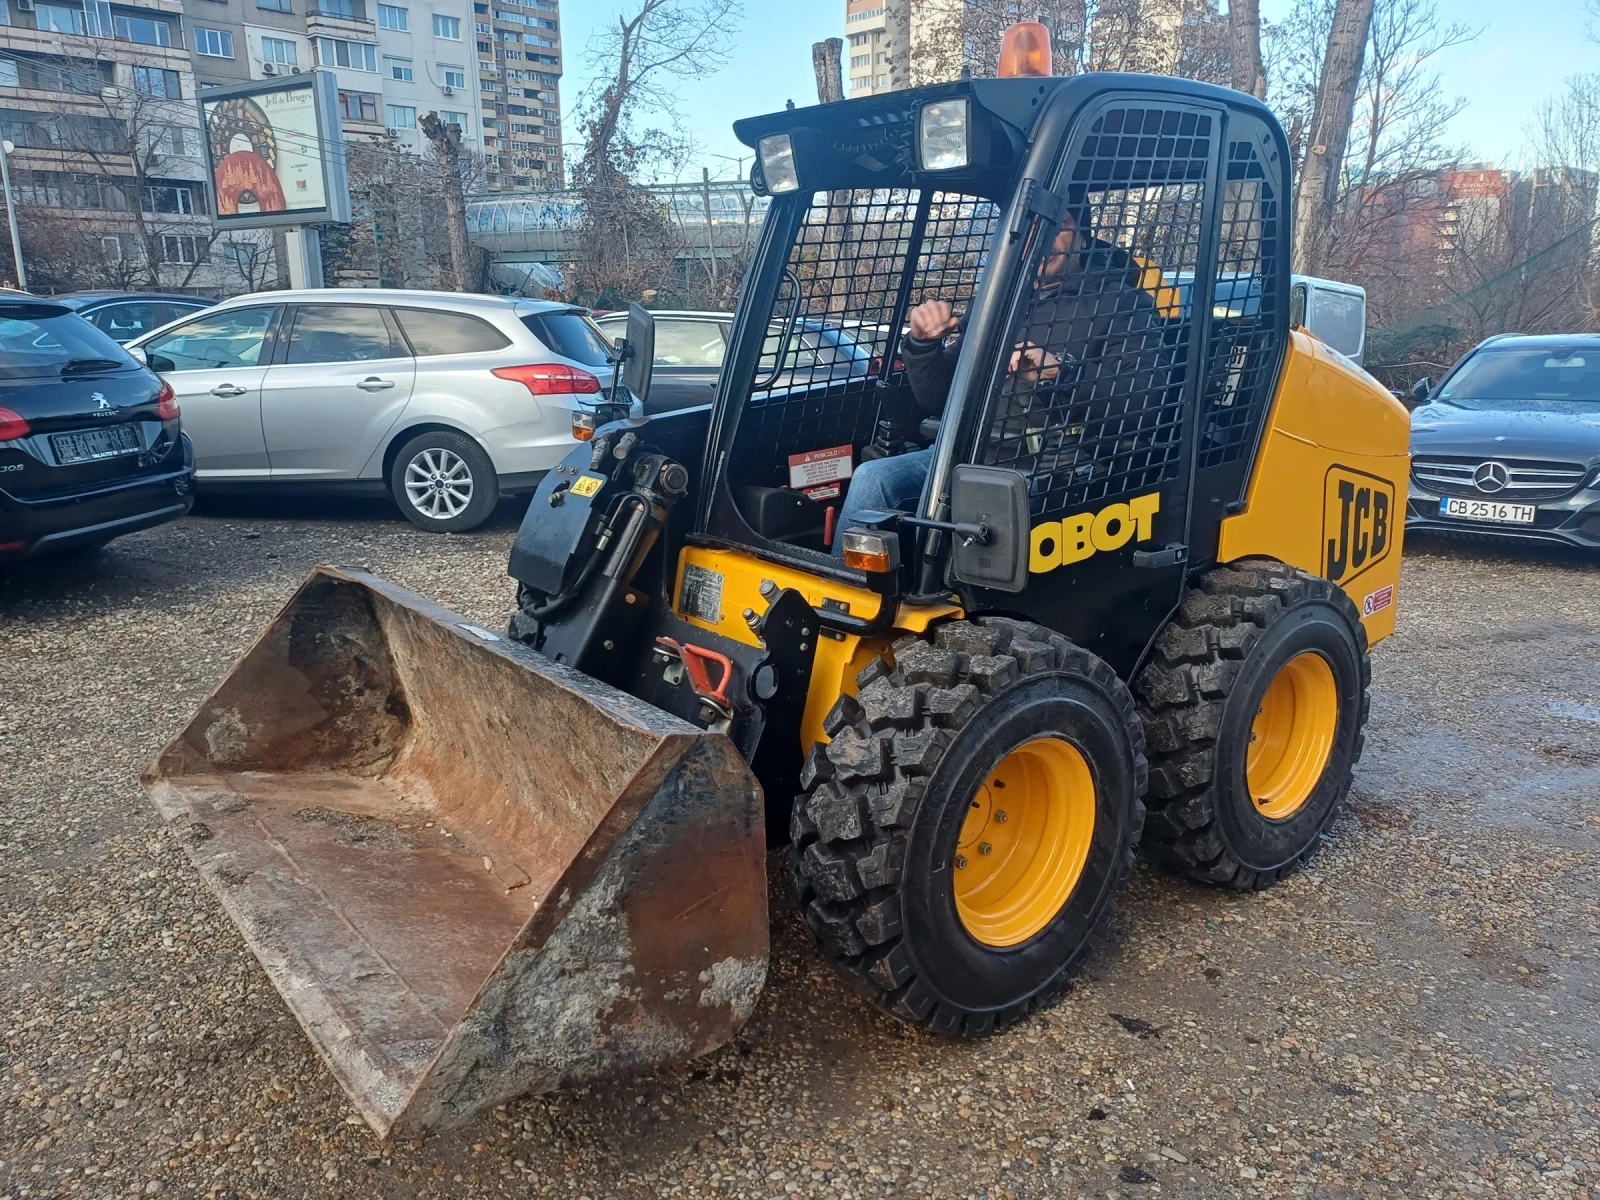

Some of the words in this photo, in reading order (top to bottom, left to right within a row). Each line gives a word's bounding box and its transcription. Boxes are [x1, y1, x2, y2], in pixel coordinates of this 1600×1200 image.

[265, 93, 277, 108] Jeff
[285, 90, 312, 104] Bruges
[813, 450, 838, 460] PERICOLO
[0, 463, 24, 473] 308
[1449, 500, 1468, 514] CB
[1470, 503, 1508, 518] 2516
[1512, 506, 1533, 521] TH
[1028, 492, 1161, 574] OBOT
[1326, 479, 1389, 581] JCB
